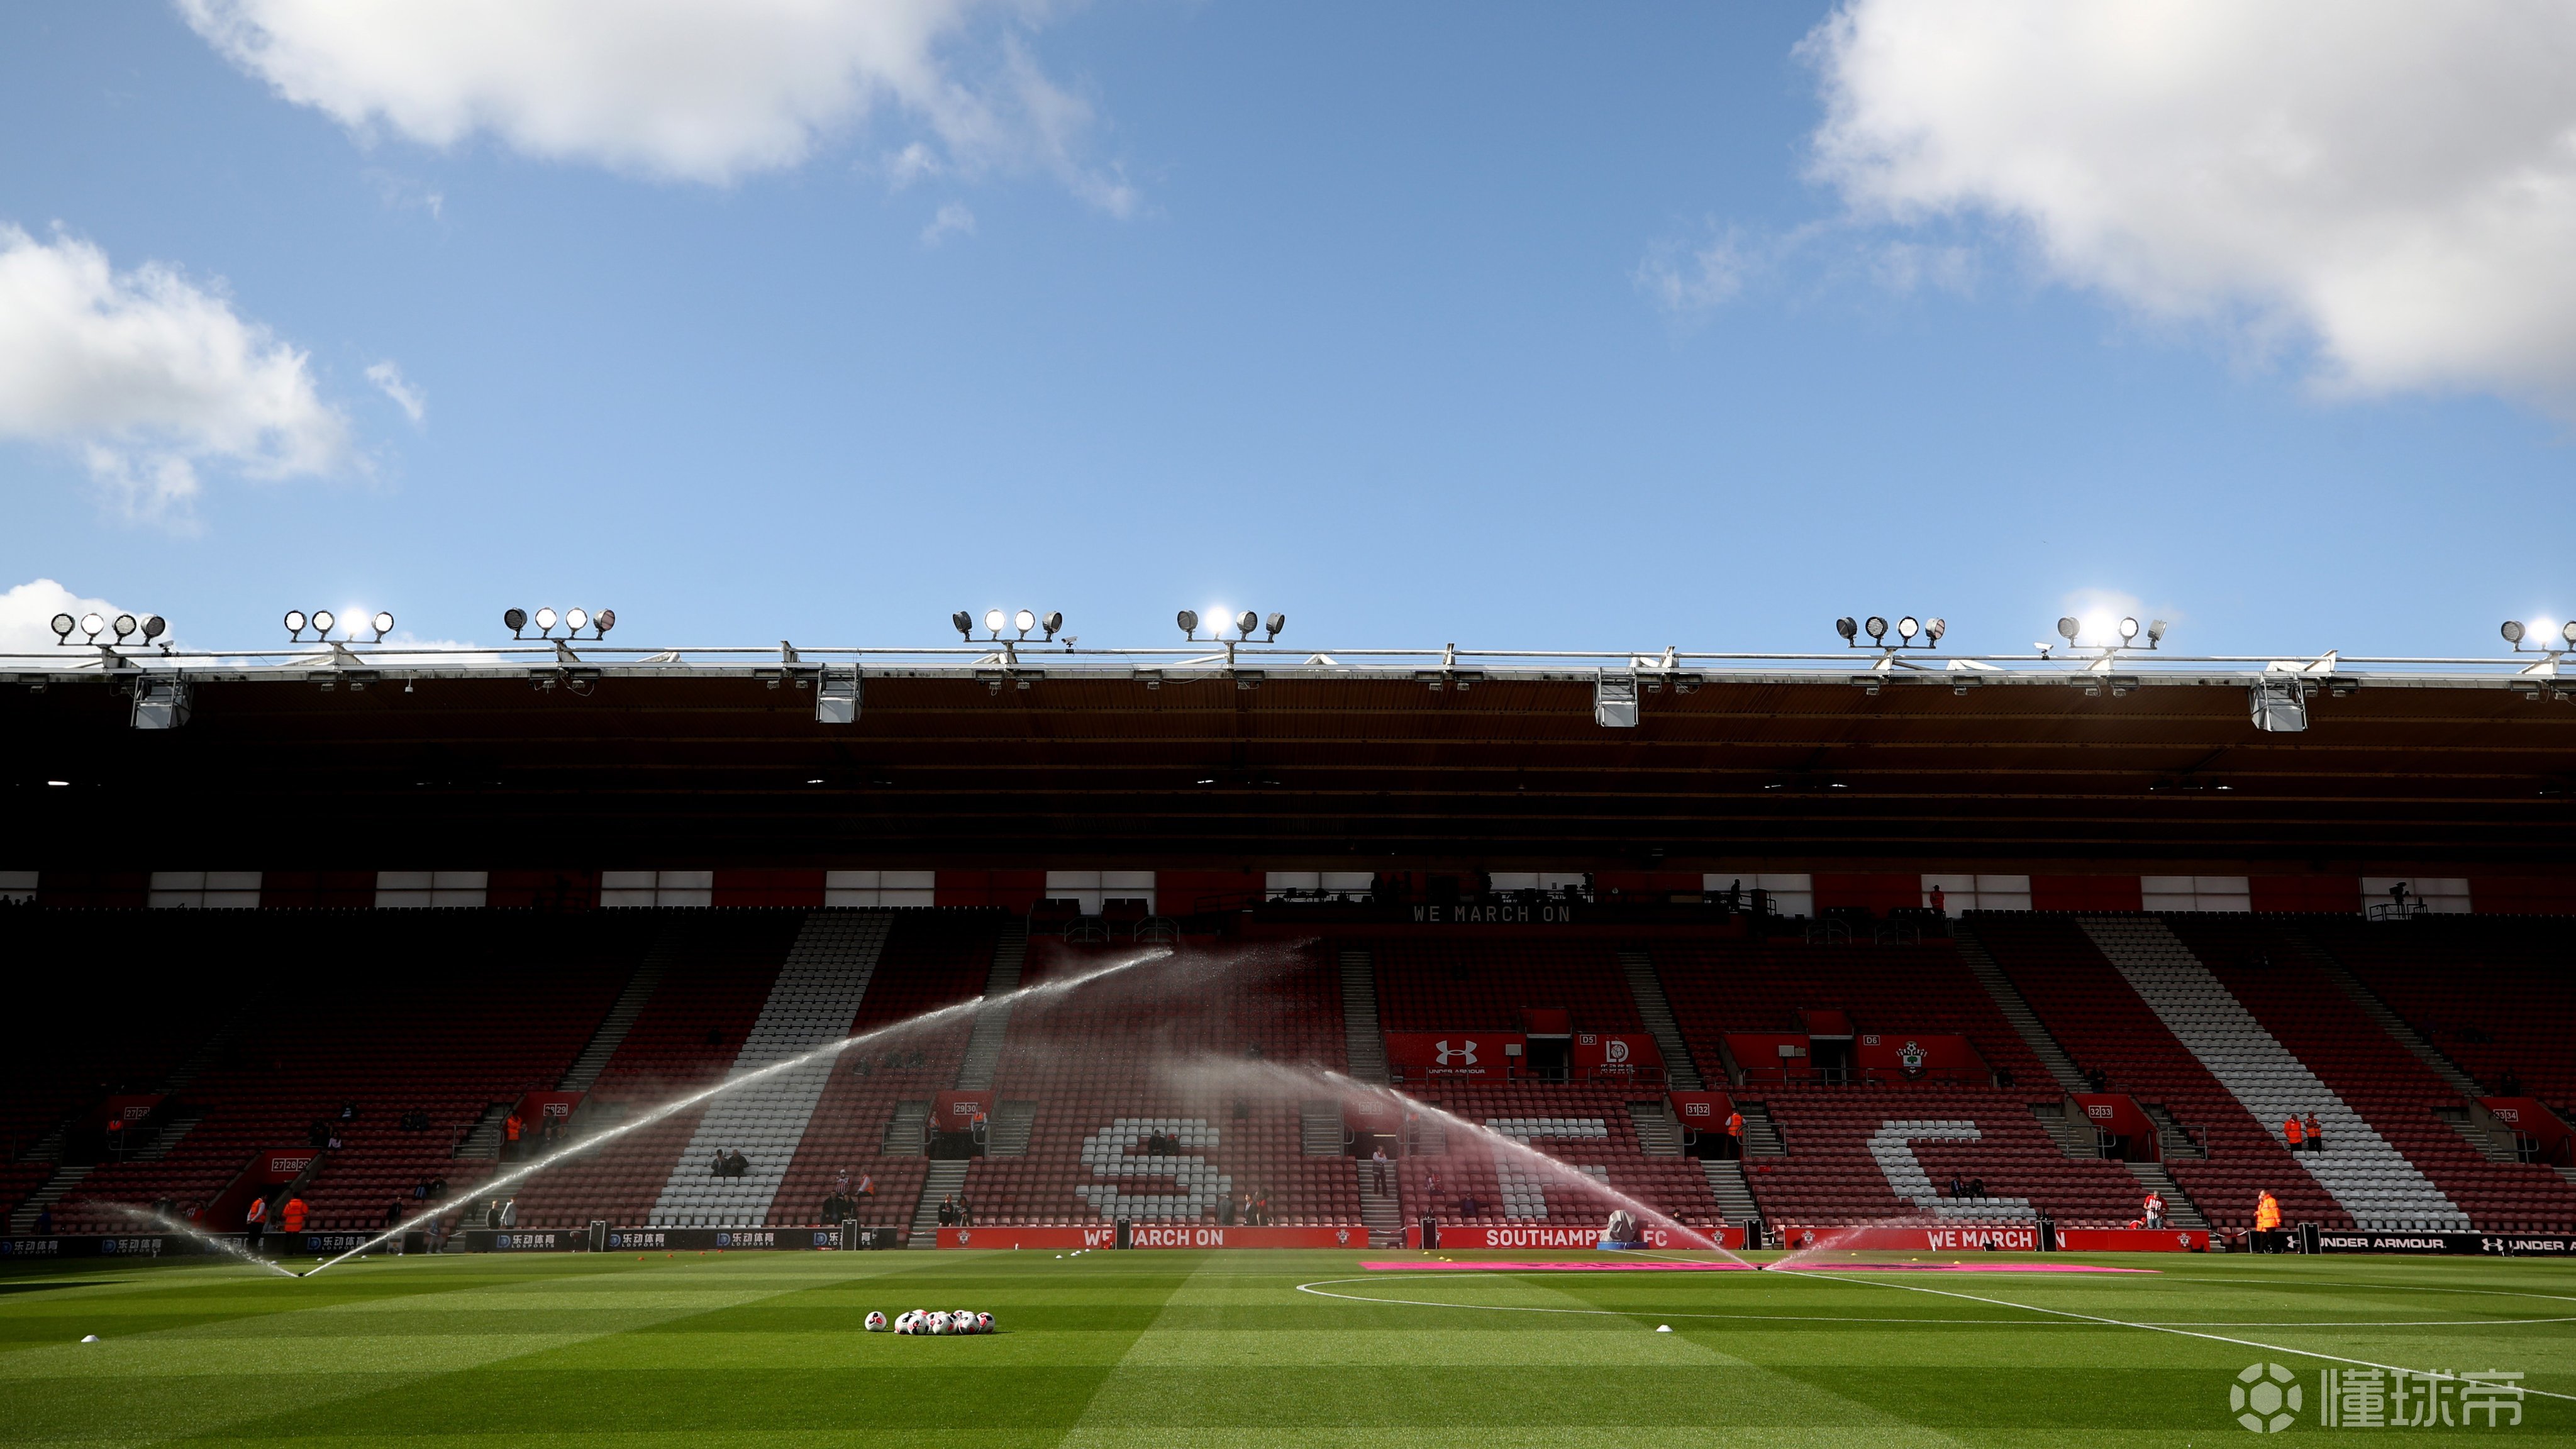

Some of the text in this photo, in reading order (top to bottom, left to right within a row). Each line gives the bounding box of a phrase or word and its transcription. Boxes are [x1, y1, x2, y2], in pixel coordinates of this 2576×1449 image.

[1414, 906, 1570, 921] WE MARCH ON
[274, 1161, 284, 1169] 27
[286, 1161, 296, 1169] 28
[512, 1234, 555, 1244] 乐动体育
[623, 1233, 665, 1243] 乐动体育
[732, 1232, 774, 1242] 乐动体育
[1196, 1230, 1223, 1246] ON
[1486, 1230, 1667, 1246] SOUTHAMP FC
[1926, 1231, 1957, 1247] WE
[1962, 1231, 2033, 1248] MARCH
[14, 1240, 58, 1250] 乐动体育
[118, 1238, 162, 1248] 乐动体育
[2508, 1240, 2565, 1251] UNDER
